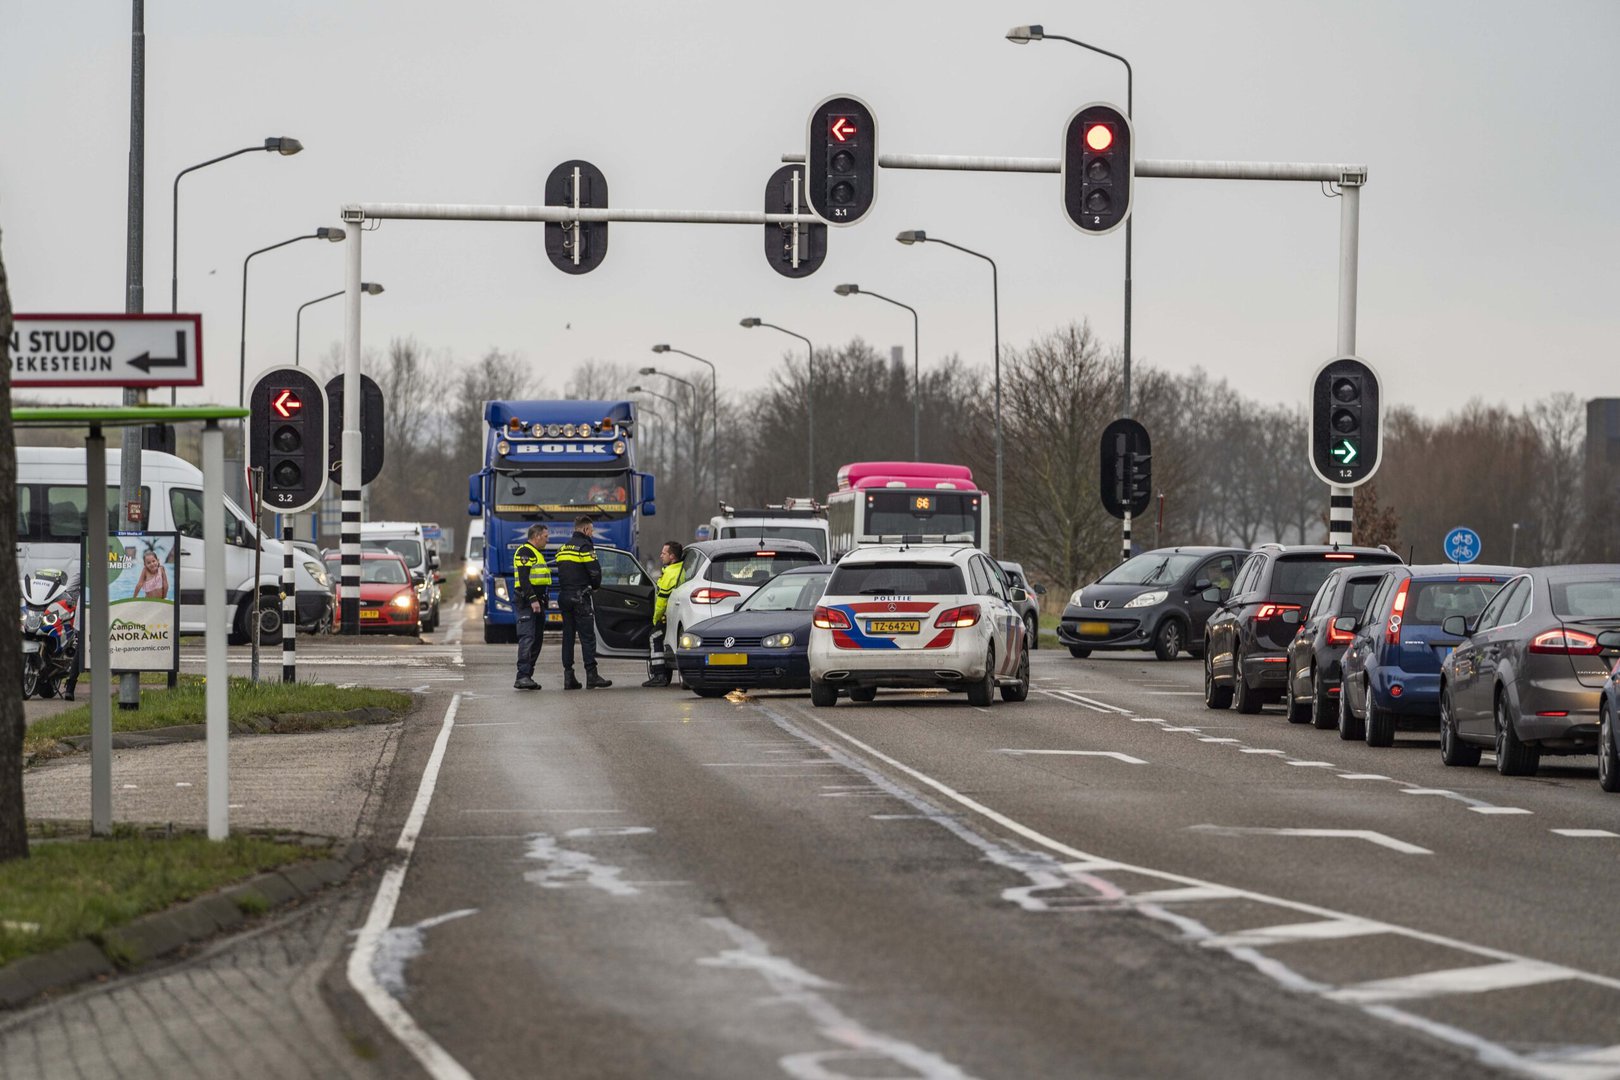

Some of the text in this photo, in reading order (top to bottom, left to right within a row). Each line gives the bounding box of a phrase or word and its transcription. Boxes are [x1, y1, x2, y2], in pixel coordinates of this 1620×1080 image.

[835, 208, 847, 216] 3.1
[29, 330, 115, 353] STUDIO
[9, 356, 112, 372] EKESTEIJN
[516, 444, 607, 454] BOLK
[1339, 470, 1352, 478] 1.2
[278, 494, 293, 502] 3.2
[916, 497, 929, 509] 66
[111, 623, 146, 632] Camping
[874, 622, 916, 631] TZ-642-V
[109, 631, 169, 641] ANORAMIC
[109, 645, 171, 654] g-le-panoramic.com
